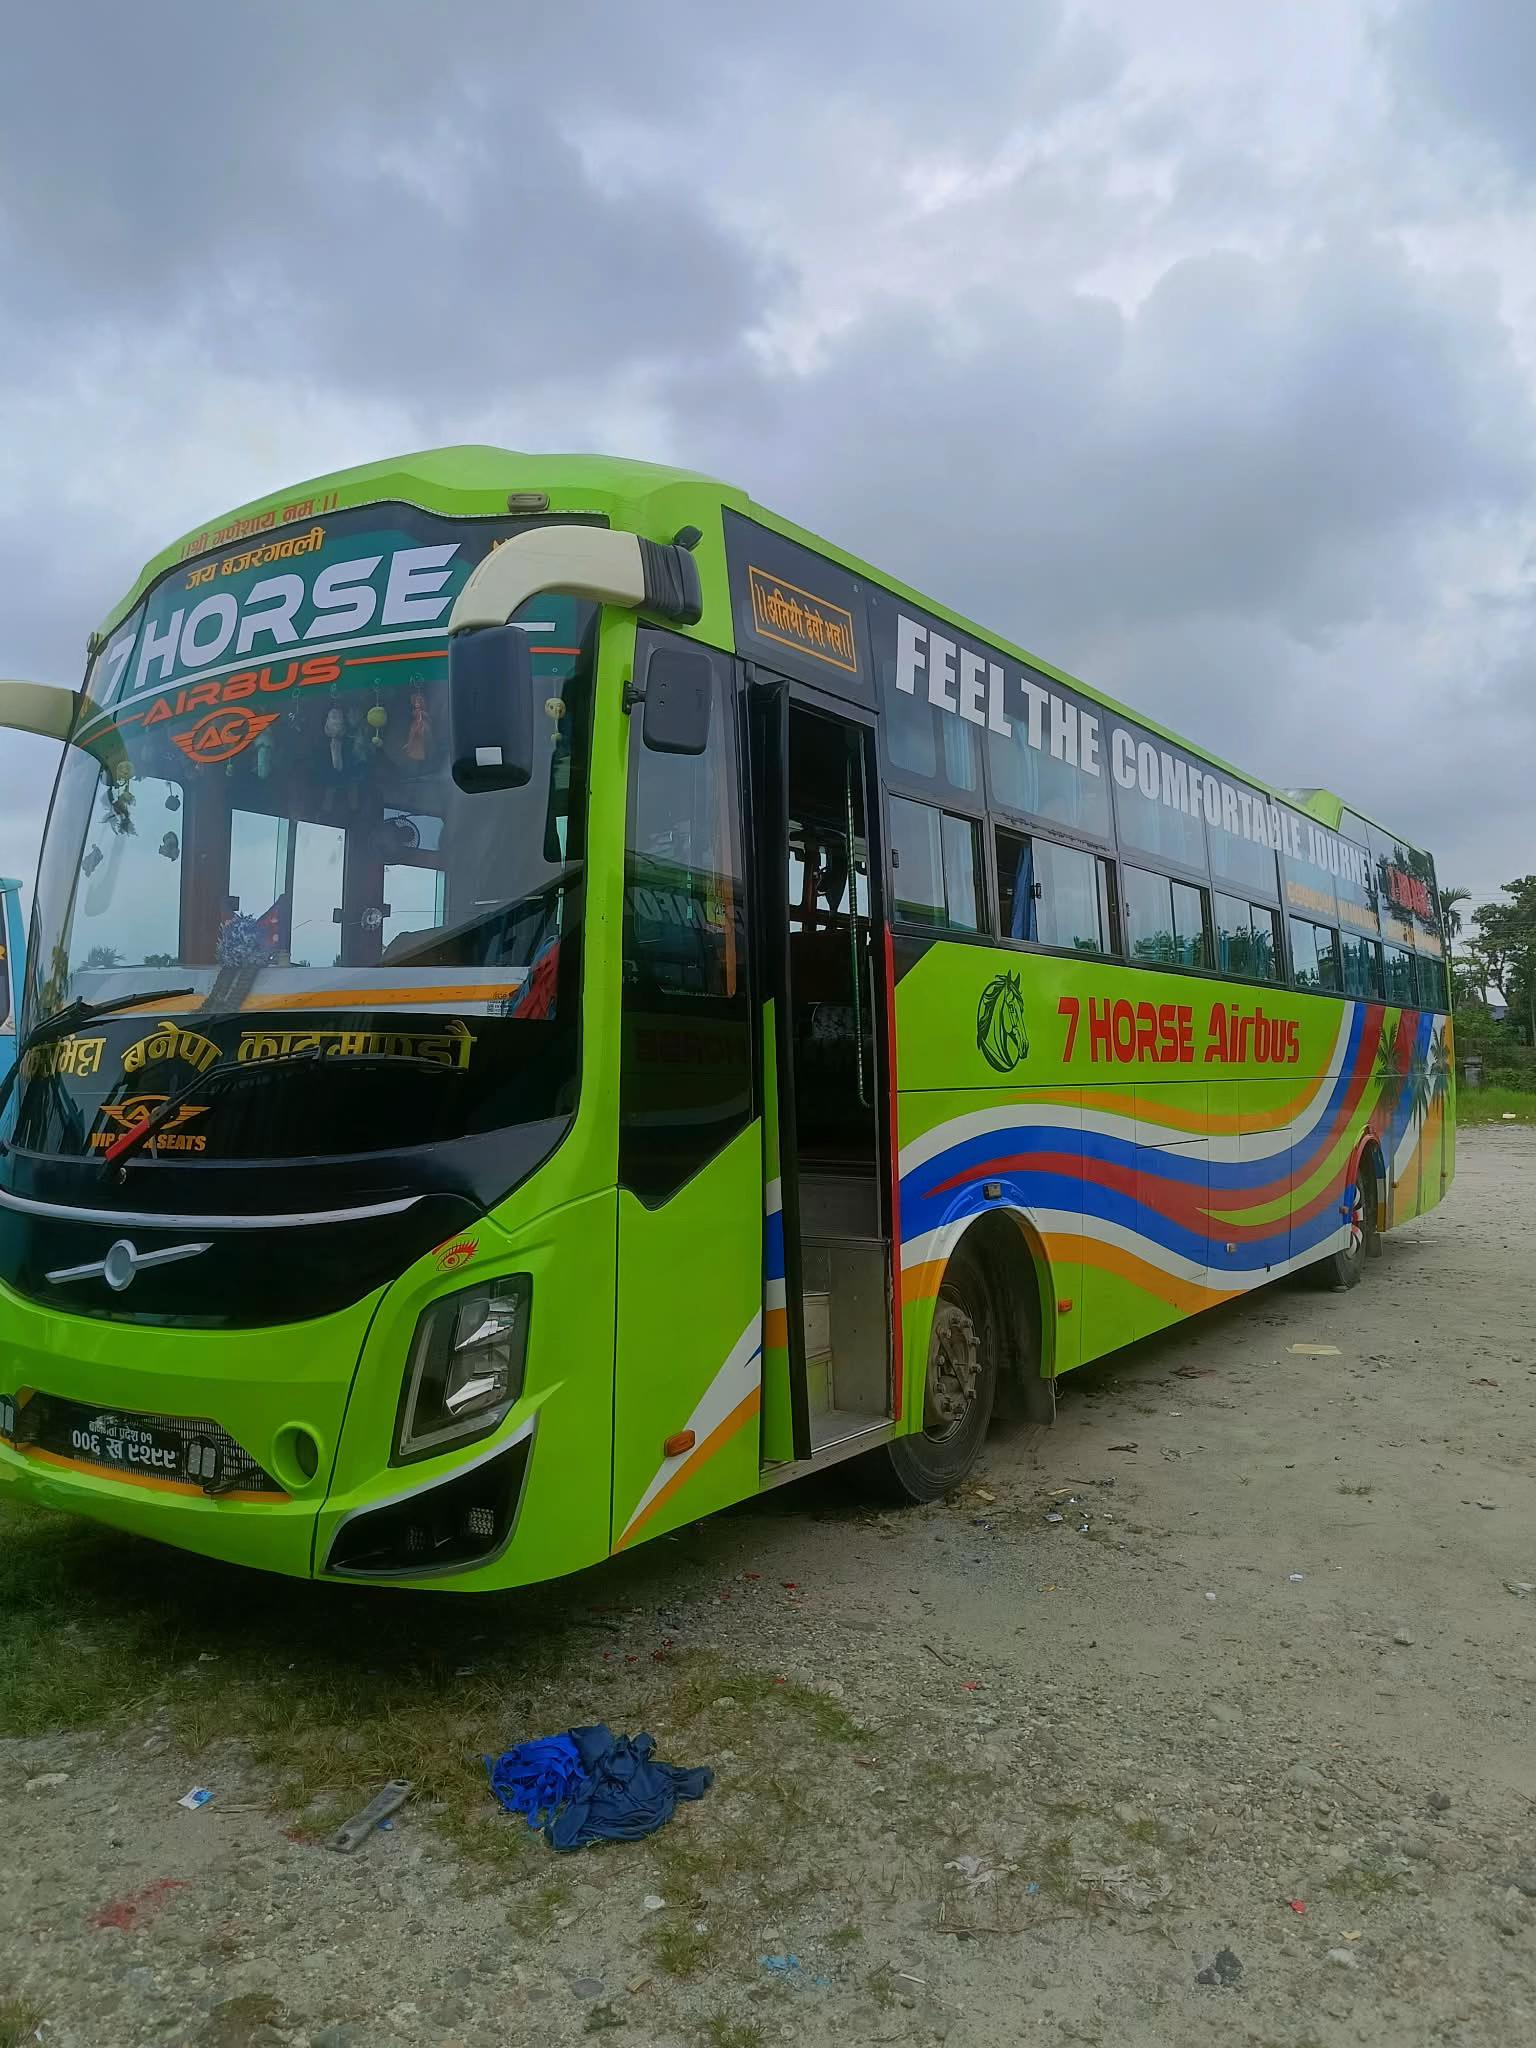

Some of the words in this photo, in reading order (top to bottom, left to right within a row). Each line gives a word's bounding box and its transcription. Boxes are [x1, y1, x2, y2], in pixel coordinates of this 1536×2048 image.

[186, 563, 218, 590] जय
[101, 632, 138, 708] 7
[135, 543, 462, 690] HORSE
[142, 655, 343, 726] AIRBUS
[200, 717, 248, 751] AC
[896, 614, 1012, 738] FEEL
[1021, 678, 1100, 777] THE
[1112, 728, 1303, 860] COMFORTABLE
[121, 1019, 223, 1073] बनेपा
[1057, 996, 1080, 1063] 7
[1088, 996, 1195, 1063] HORSE
[1204, 1002, 1300, 1063] Airbus
[91, 1132, 114, 1148] VIP
[156, 1135, 207, 1151] SEATS
[105, 1436, 124, 1459] ख
